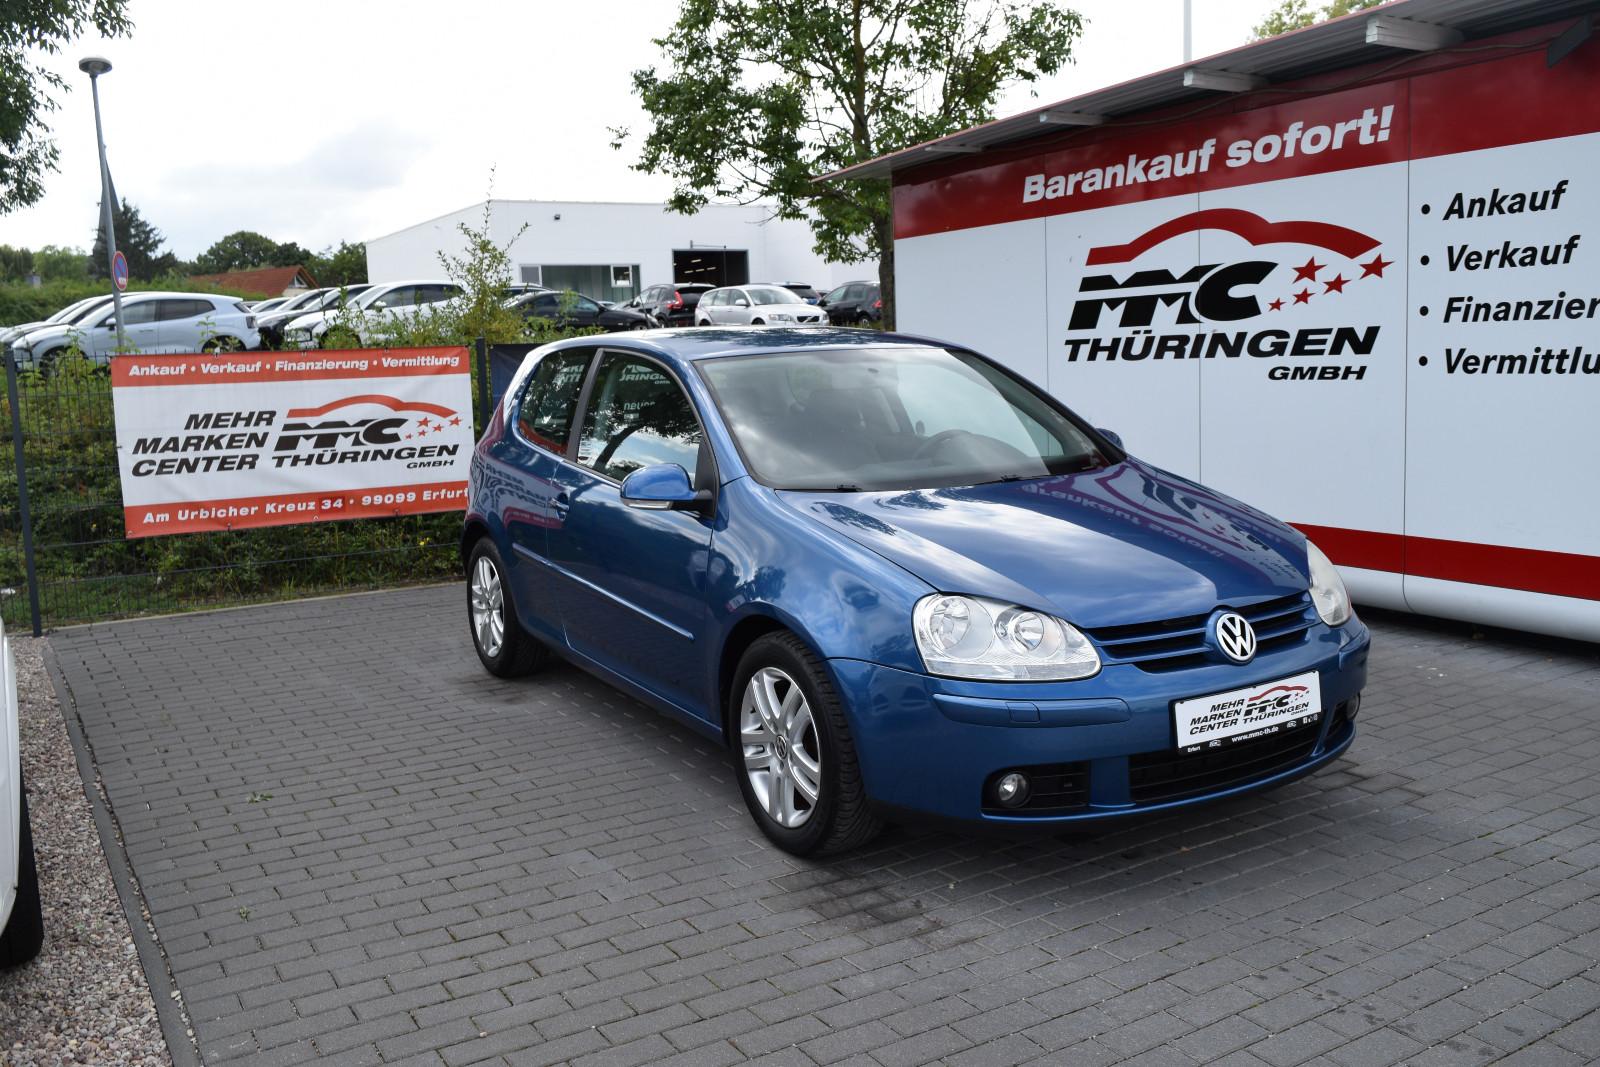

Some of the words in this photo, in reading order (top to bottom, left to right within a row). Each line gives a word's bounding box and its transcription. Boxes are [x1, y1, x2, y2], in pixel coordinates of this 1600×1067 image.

[1022, 138, 1216, 203] Barankauf
[1226, 105, 1394, 166] sofort!
[1442, 180, 1569, 220] Ankauf
[1447, 235, 1581, 272] Verkauf
[1064, 326, 1380, 362] THÜRINGEN
[129, 363, 187, 376] Ankauf
[201, 361, 261, 374] Verkauf
[275, 359, 369, 372] Finanzierung
[382, 355, 460, 368] Vermittlung
[1268, 366, 1367, 381] GMBH
[184, 410, 277, 430] MEHR
[132, 432, 269, 455] MARKEN
[131, 454, 259, 477] CENTER
[272, 444, 459, 468] THÜRINGEN
[406, 460, 454, 469] GMBH
[143, 512, 170, 523] Am
[178, 505, 258, 521] Urbicher
[265, 500, 316, 514] Kreuz
[321, 498, 343, 510] 34
[362, 492, 416, 506] 99099
[423, 486, 468, 501] Erfurt
[1190, 708, 1242, 726] MARKEN
[1190, 718, 1238, 735] CENTER
[1242, 702, 1310, 724] THÜRINGEN
[1210, 699, 1245, 713] MEHR
